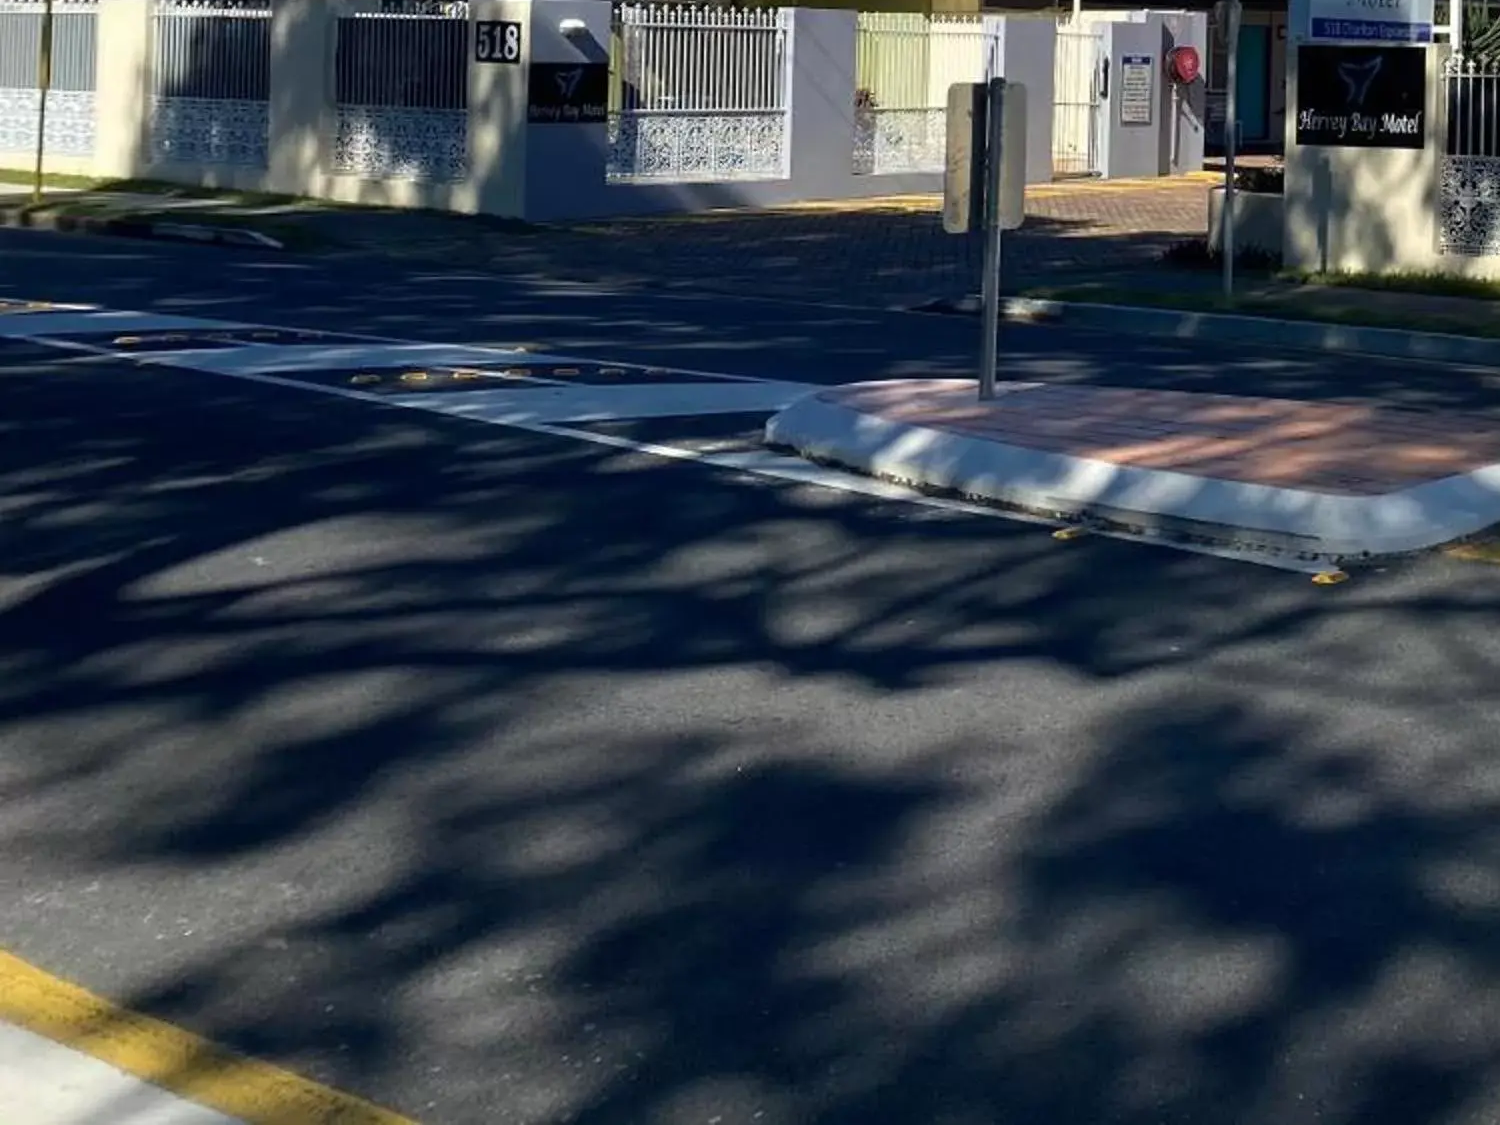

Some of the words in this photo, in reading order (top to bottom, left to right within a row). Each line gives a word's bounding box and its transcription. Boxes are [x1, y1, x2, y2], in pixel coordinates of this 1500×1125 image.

[478, 24, 518, 60] 518
[1299, 108, 1347, 139] Hervey
[1351, 112, 1377, 140] Bay
[1380, 110, 1422, 134] Motel
